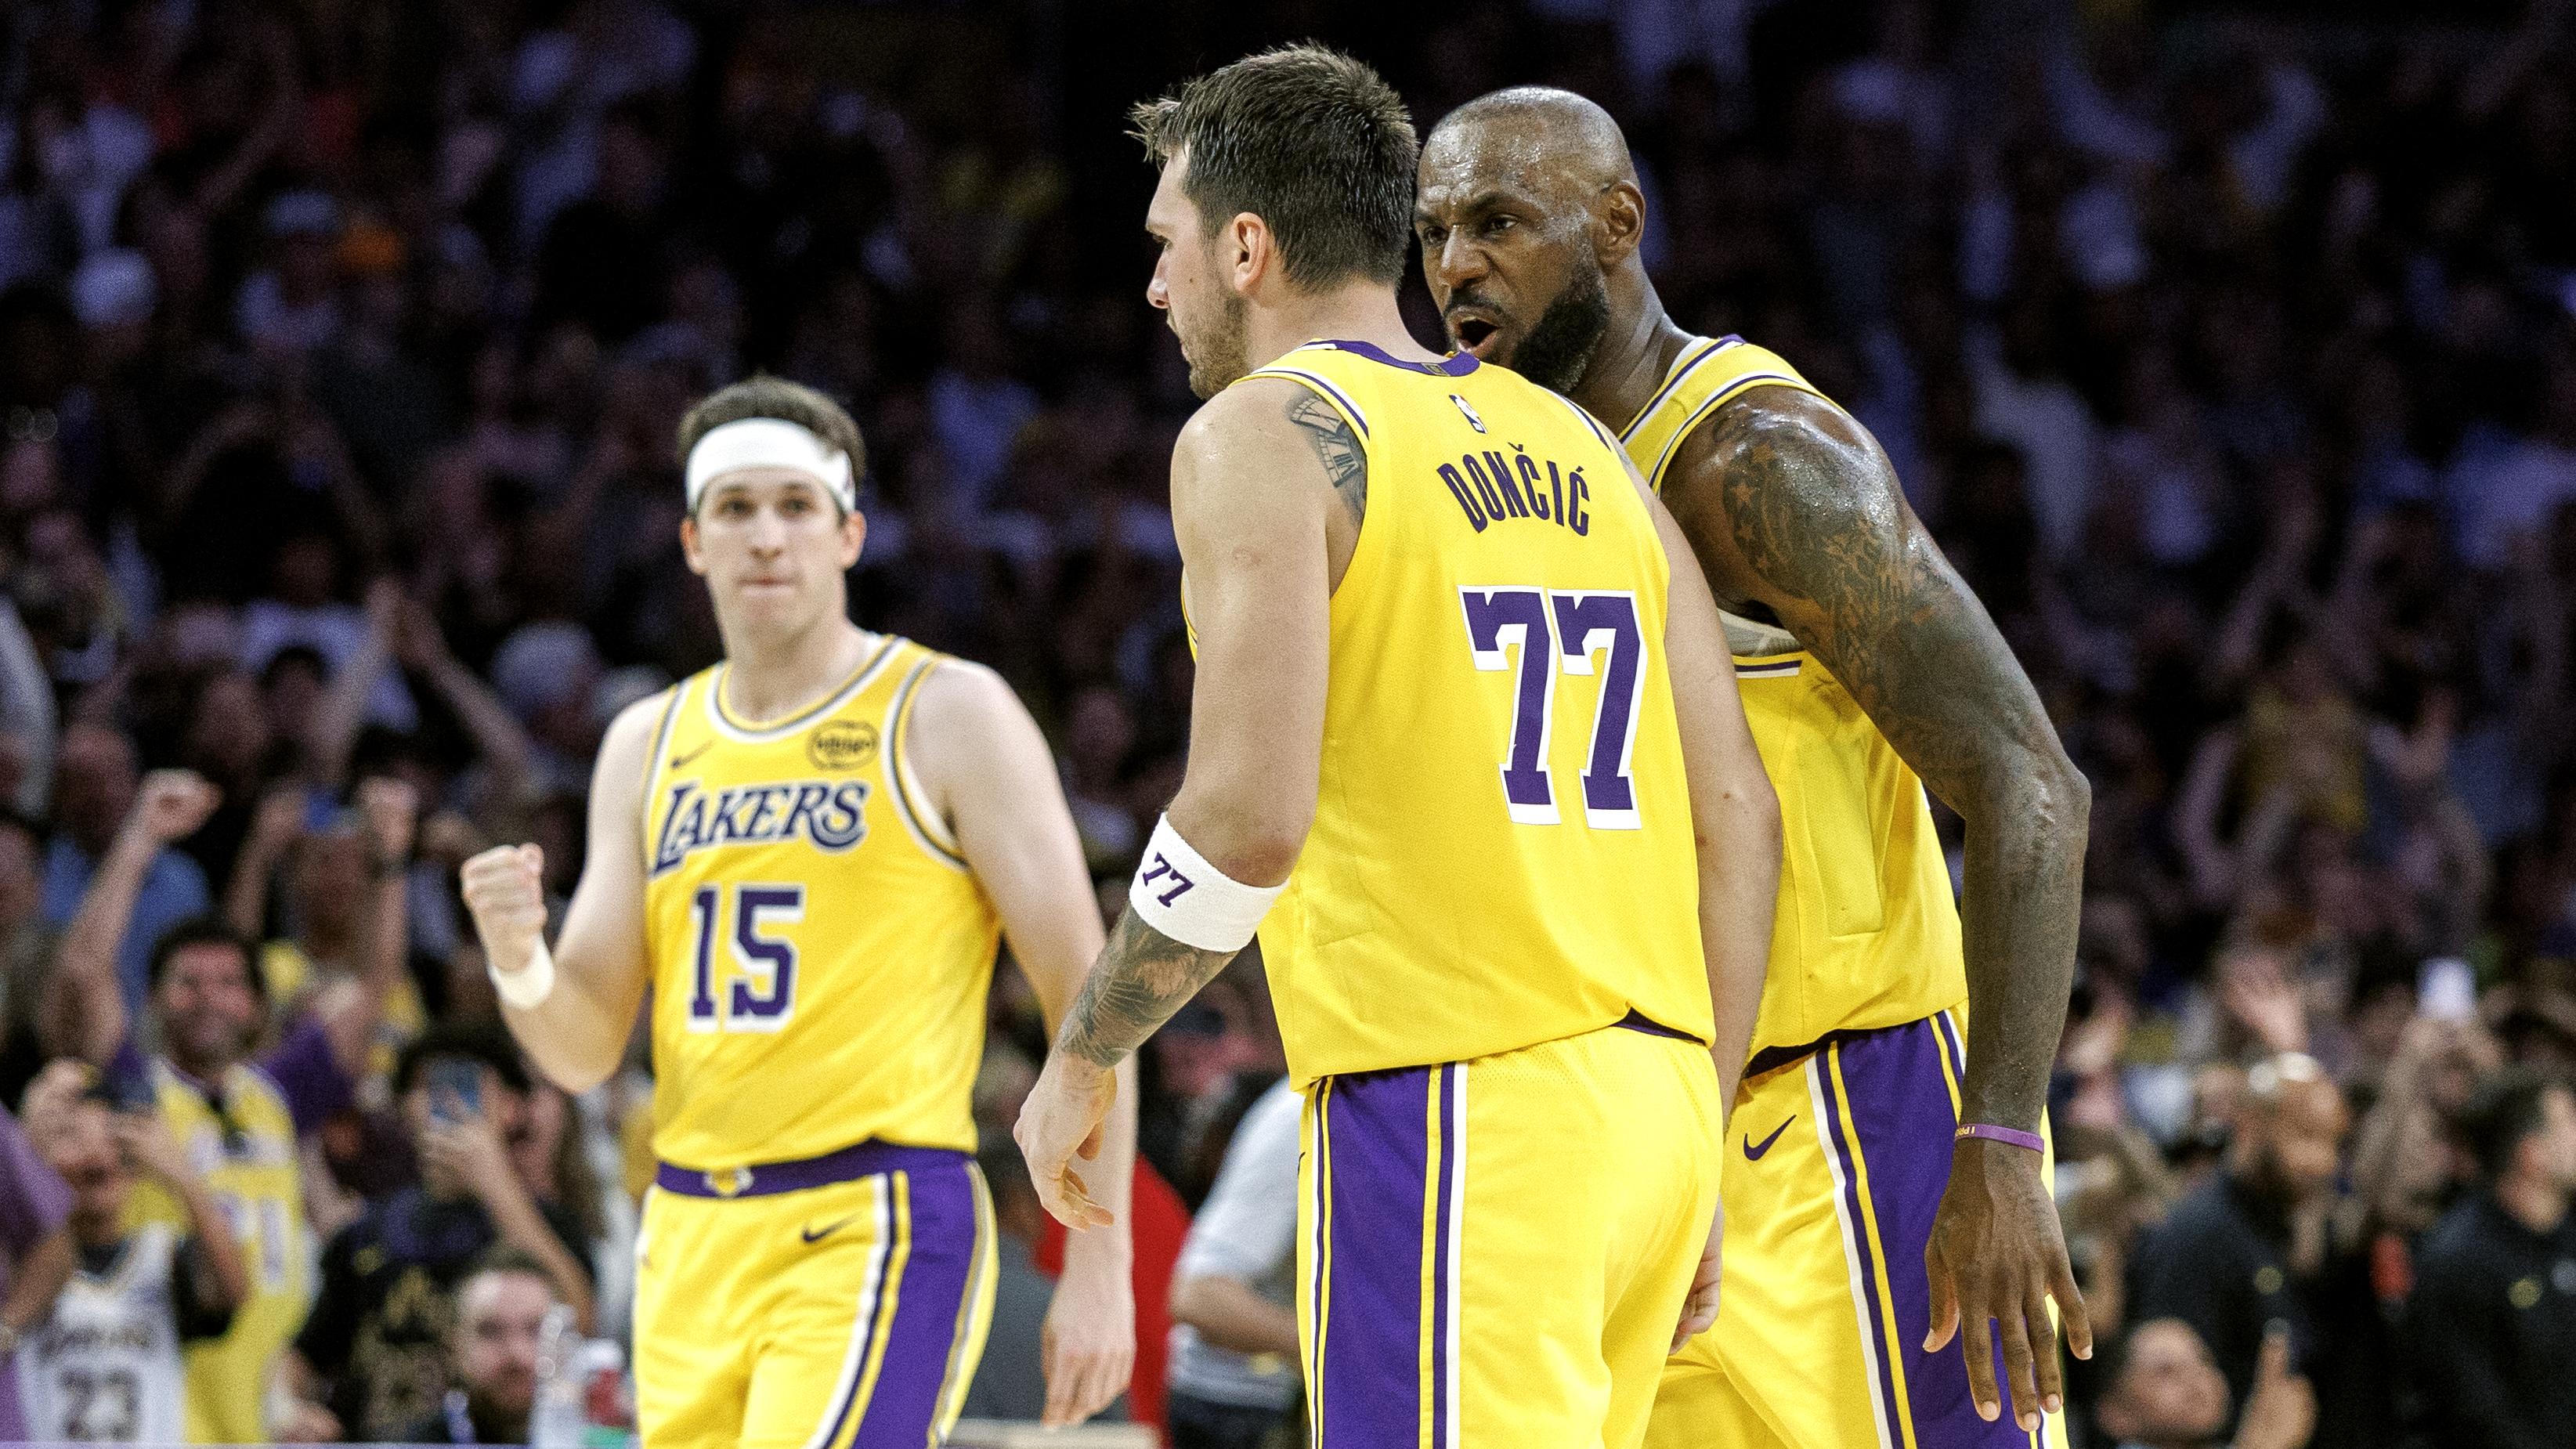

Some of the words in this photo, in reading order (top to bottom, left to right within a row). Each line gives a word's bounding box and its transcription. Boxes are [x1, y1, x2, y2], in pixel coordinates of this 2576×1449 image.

[1436, 442, 1589, 537] DONČIĆ
[1459, 586, 1647, 828] 77
[651, 781, 869, 876] LAKERS
[1142, 851, 1194, 908] 77
[688, 886, 804, 1028] 15
